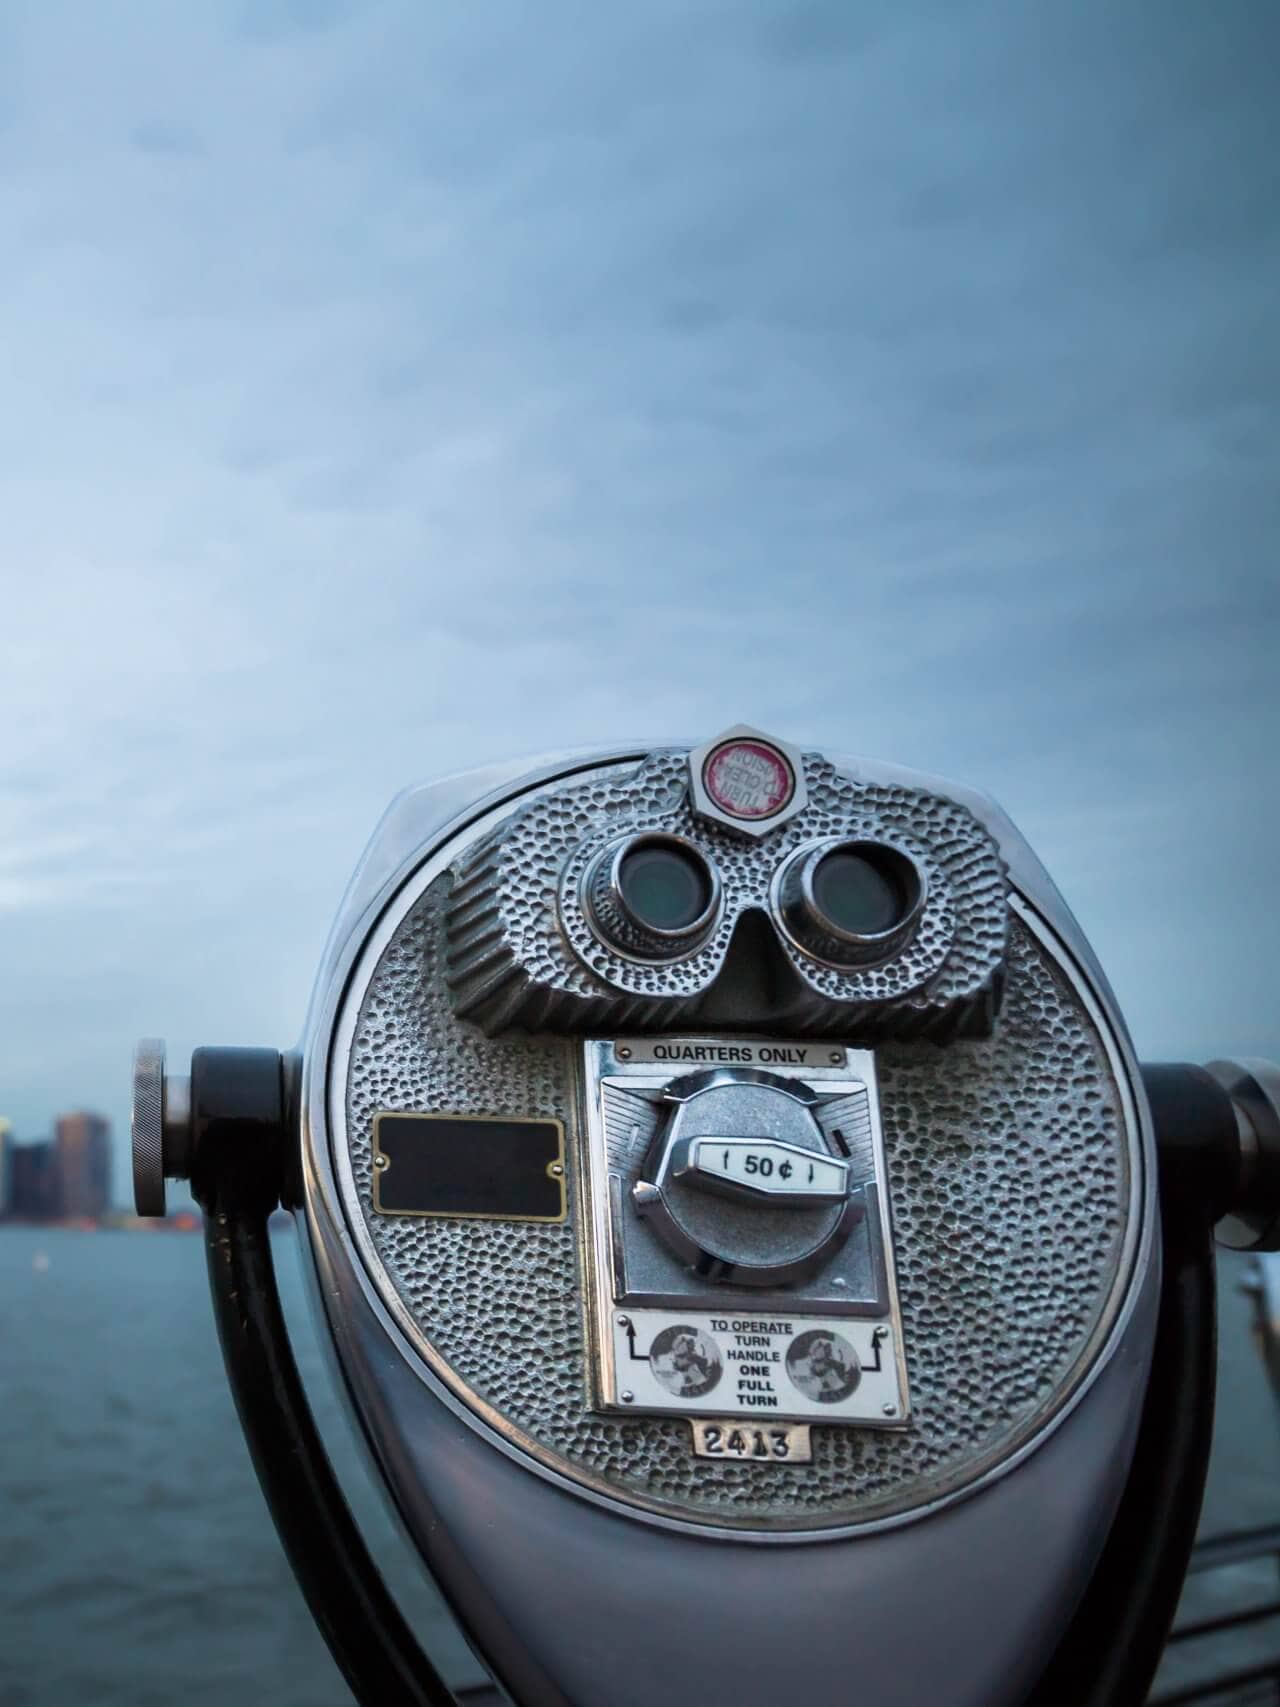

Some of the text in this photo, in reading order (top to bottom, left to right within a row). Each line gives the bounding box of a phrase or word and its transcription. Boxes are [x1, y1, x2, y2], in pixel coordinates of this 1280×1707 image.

[653, 1045, 808, 1063] QUARTERS ONLY
[710, 1320, 793, 1335] TO OPERATE
[734, 1335, 770, 1347] TURN
[727, 1349, 781, 1362] HANDLE
[739, 1364, 770, 1376] ONE
[737, 1380, 775, 1392] FULL
[736, 1394, 778, 1407] TURN
[704, 1426, 789, 1457] 2413
